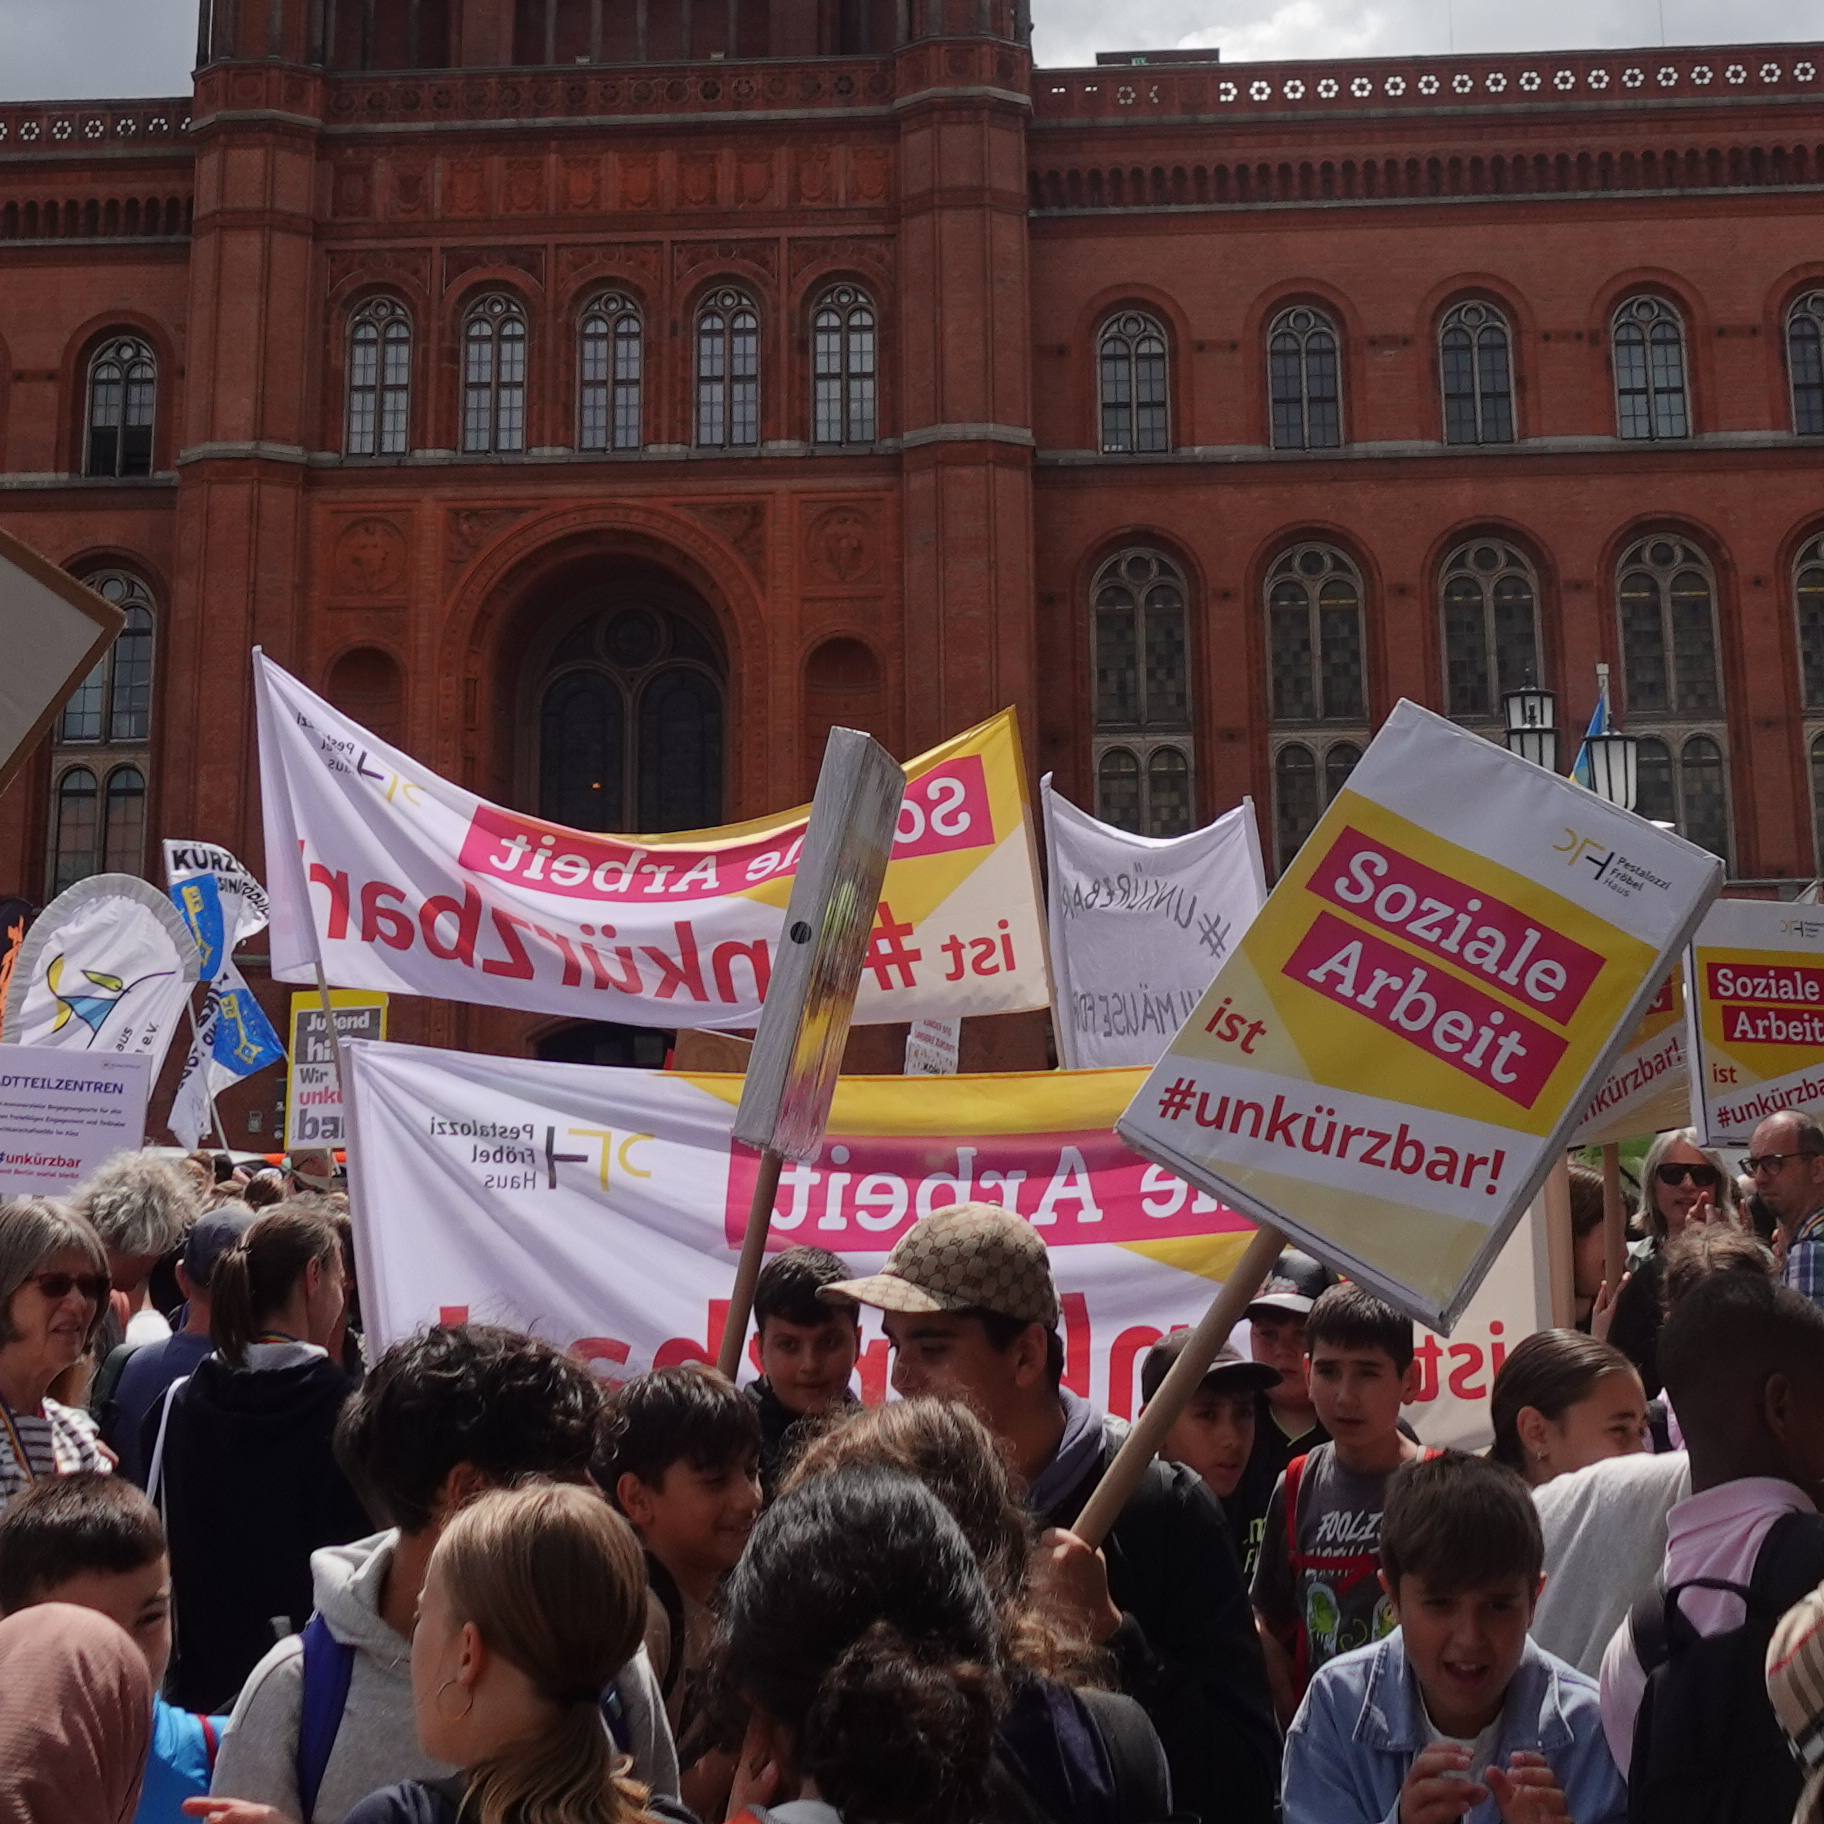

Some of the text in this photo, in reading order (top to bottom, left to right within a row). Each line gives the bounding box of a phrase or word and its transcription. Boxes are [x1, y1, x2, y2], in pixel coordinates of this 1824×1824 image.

[1603, 877, 1631, 898] Haus
[1609, 868, 1645, 891] Fröbel
[1617, 856, 1672, 891] Pestalozzi
[1333, 850, 1568, 1004] Soziale
[1716, 968, 1821, 1001] Soziale
[1204, 997, 1267, 1055] ist
[1307, 939, 1529, 1085] Arbeit
[299, 1066, 329, 1084] Wir
[1712, 1062, 1738, 1084] ist
[1157, 1076, 1507, 1197] #unkürzbar!
